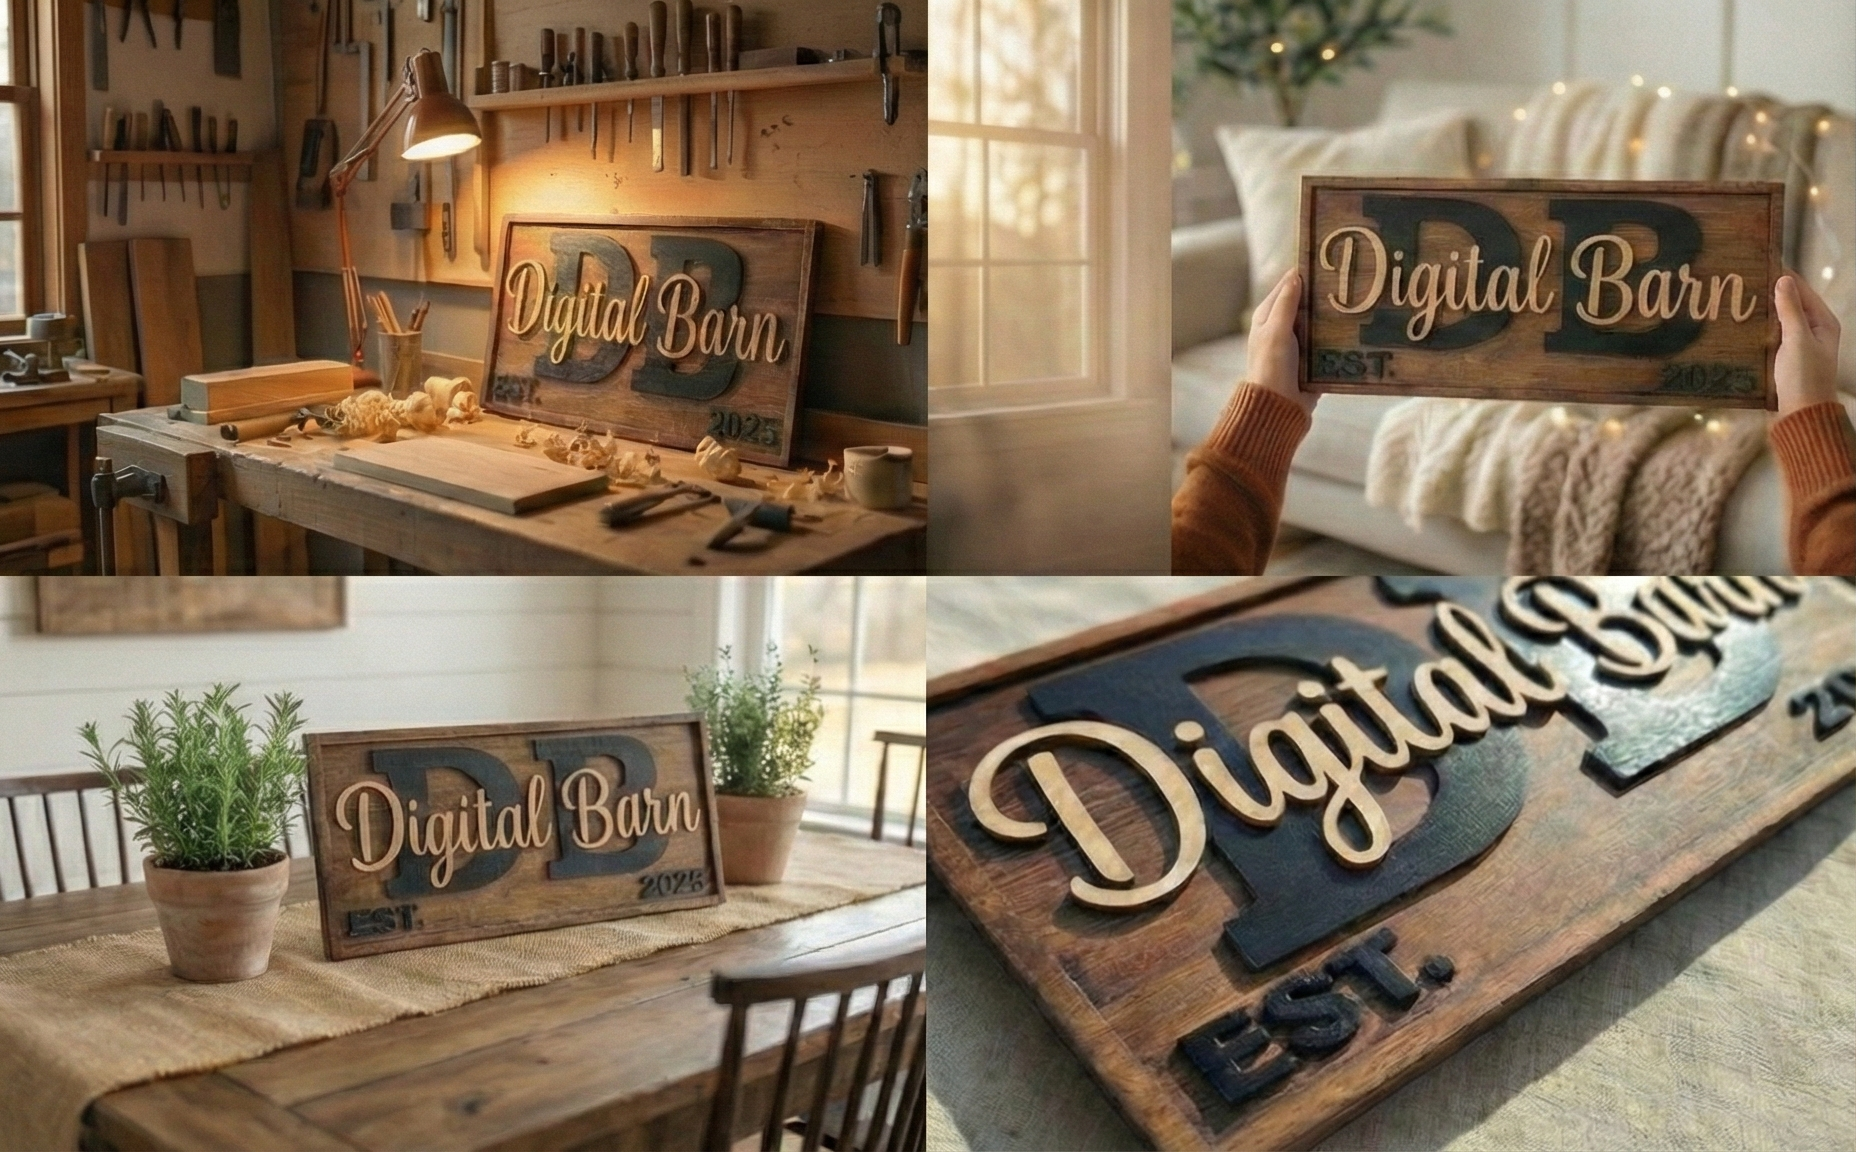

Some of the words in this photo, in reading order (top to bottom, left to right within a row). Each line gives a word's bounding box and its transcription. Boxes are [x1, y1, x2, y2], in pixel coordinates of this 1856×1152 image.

[506, 259, 650, 365] Digital
[656, 273, 789, 363] Barn
[1319, 225, 1555, 342] Digital
[1570, 234, 1758, 327] Barn
[1318, 349, 1395, 379] EST.
[968, 600, 1567, 914] Digital
[335, 774, 552, 889] Digital
[561, 768, 701, 849] Barn
[1177, 927, 1455, 1104] EST.
